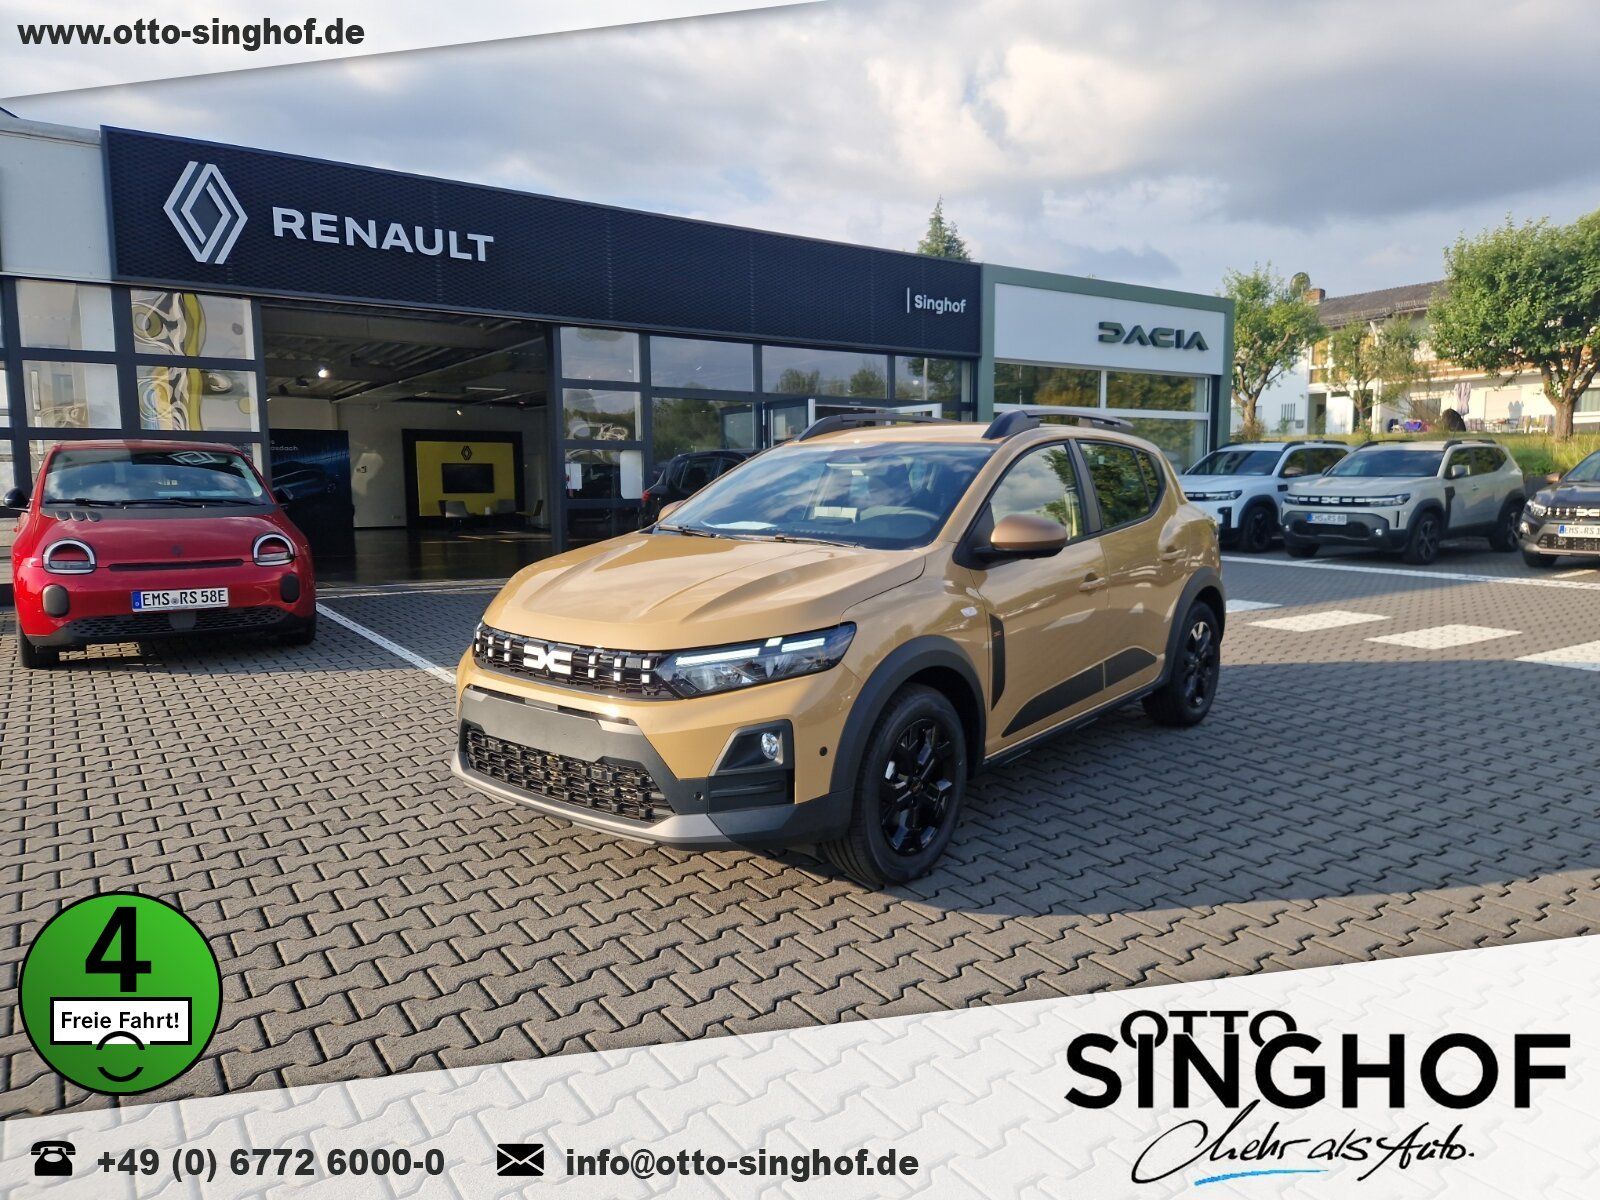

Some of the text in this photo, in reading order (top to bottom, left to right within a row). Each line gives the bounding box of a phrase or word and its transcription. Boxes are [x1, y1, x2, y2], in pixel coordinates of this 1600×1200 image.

[272, 207, 494, 262] RENAULT
[914, 294, 967, 315] Singhof
[1097, 321, 1209, 351] DACIA
[142, 589, 226, 607] EMS RS 58E
